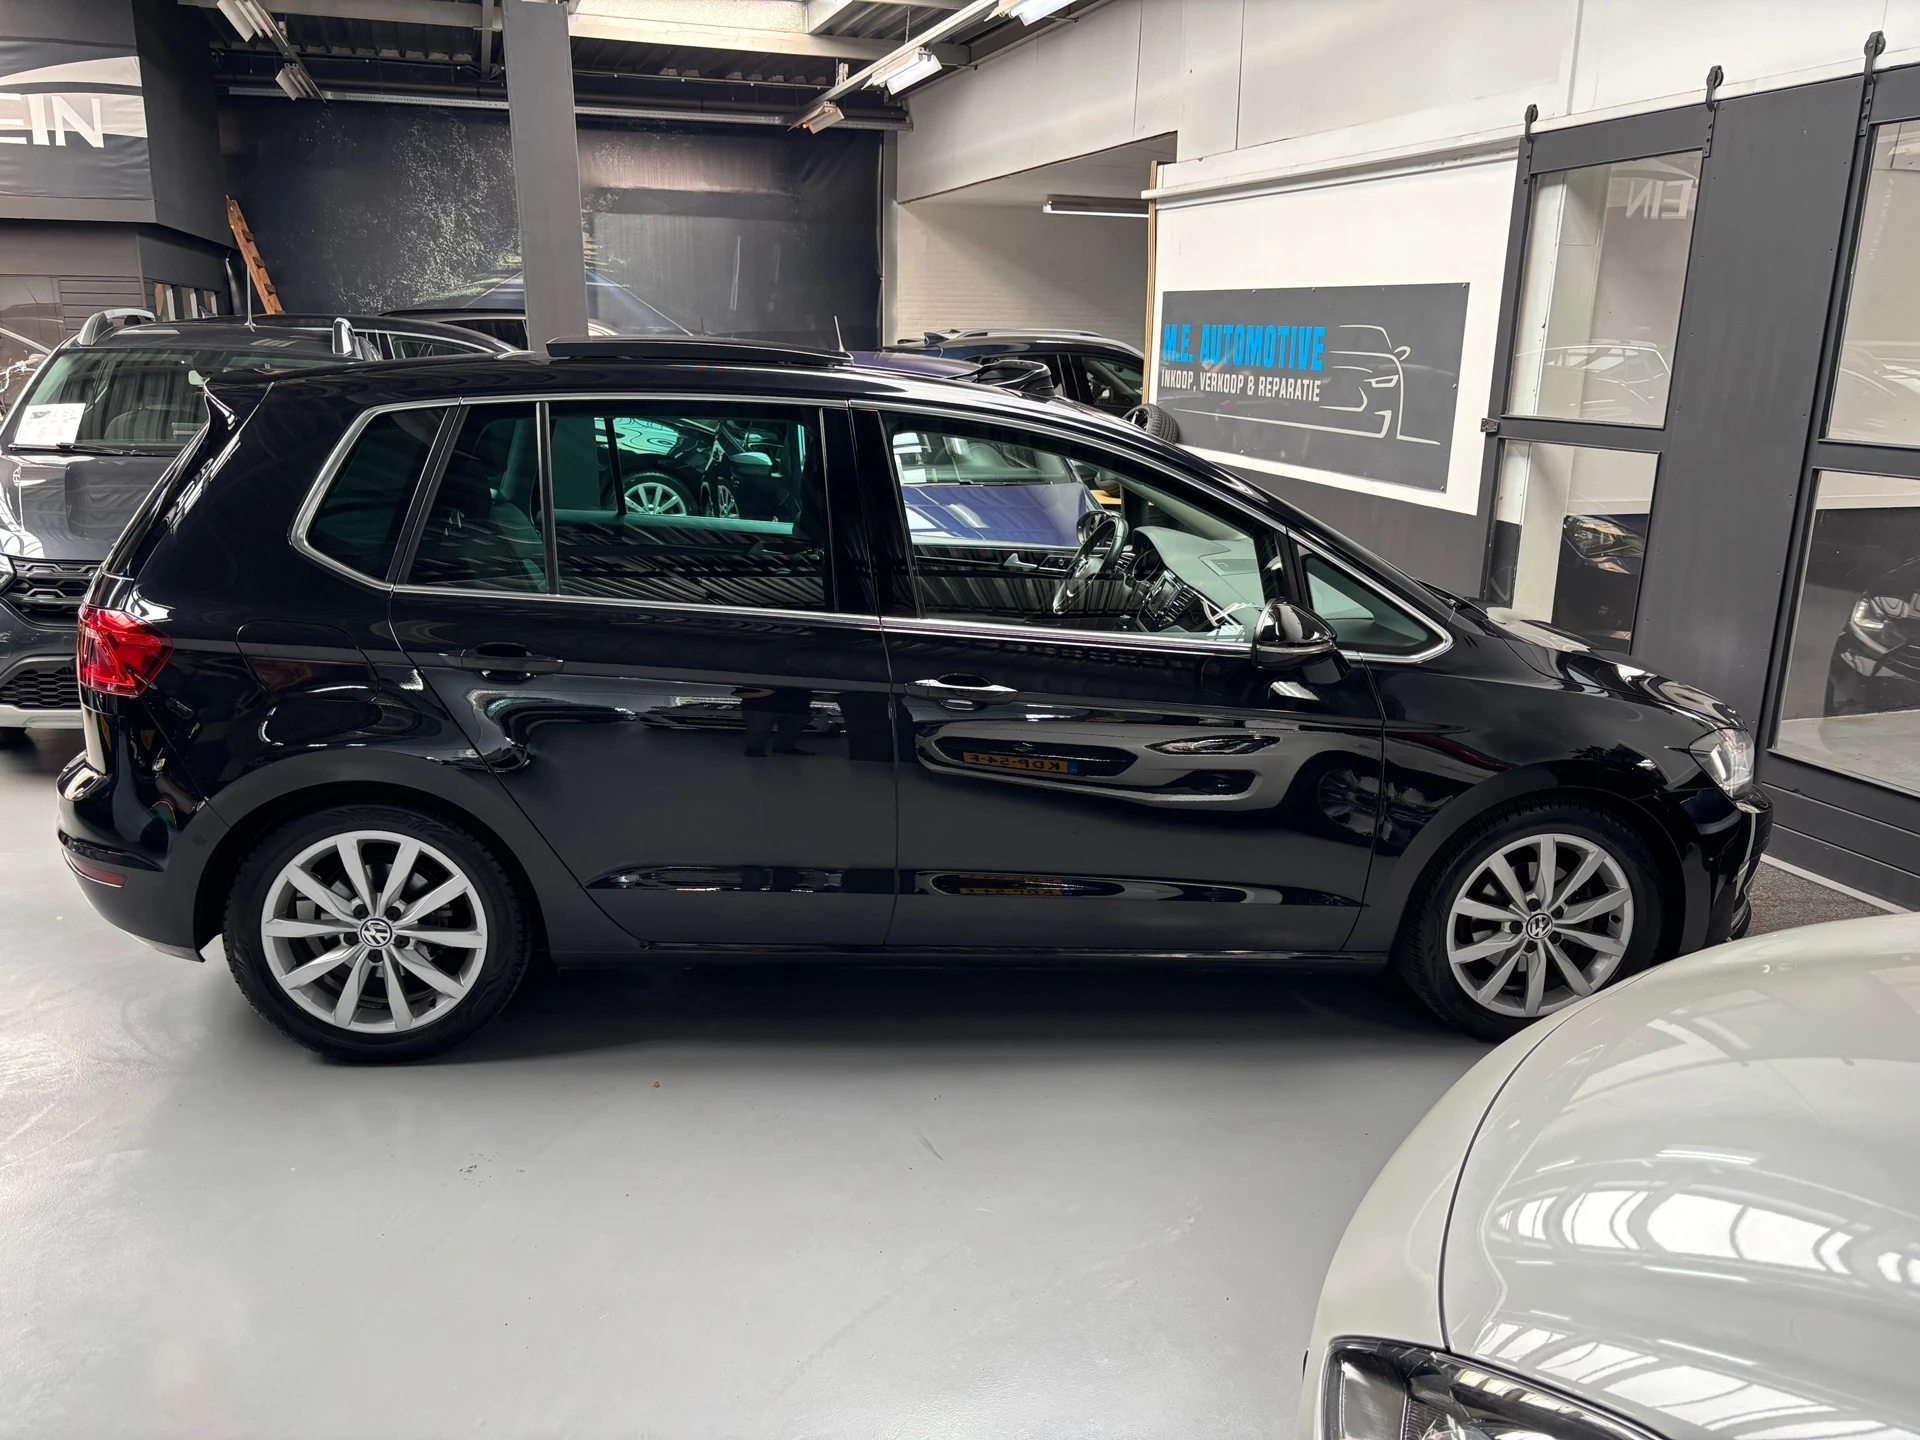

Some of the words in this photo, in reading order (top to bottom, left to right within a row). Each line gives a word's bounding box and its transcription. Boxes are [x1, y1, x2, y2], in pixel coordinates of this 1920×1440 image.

[1162, 324, 1194, 363] M.E.
[1199, 324, 1326, 372] AUTOMOTIVE
[1161, 369, 1196, 393] INKOOP,
[1200, 372, 1244, 395] VERKOOP
[1247, 375, 1254, 396] &
[1258, 376, 1322, 402] REPARATIE
